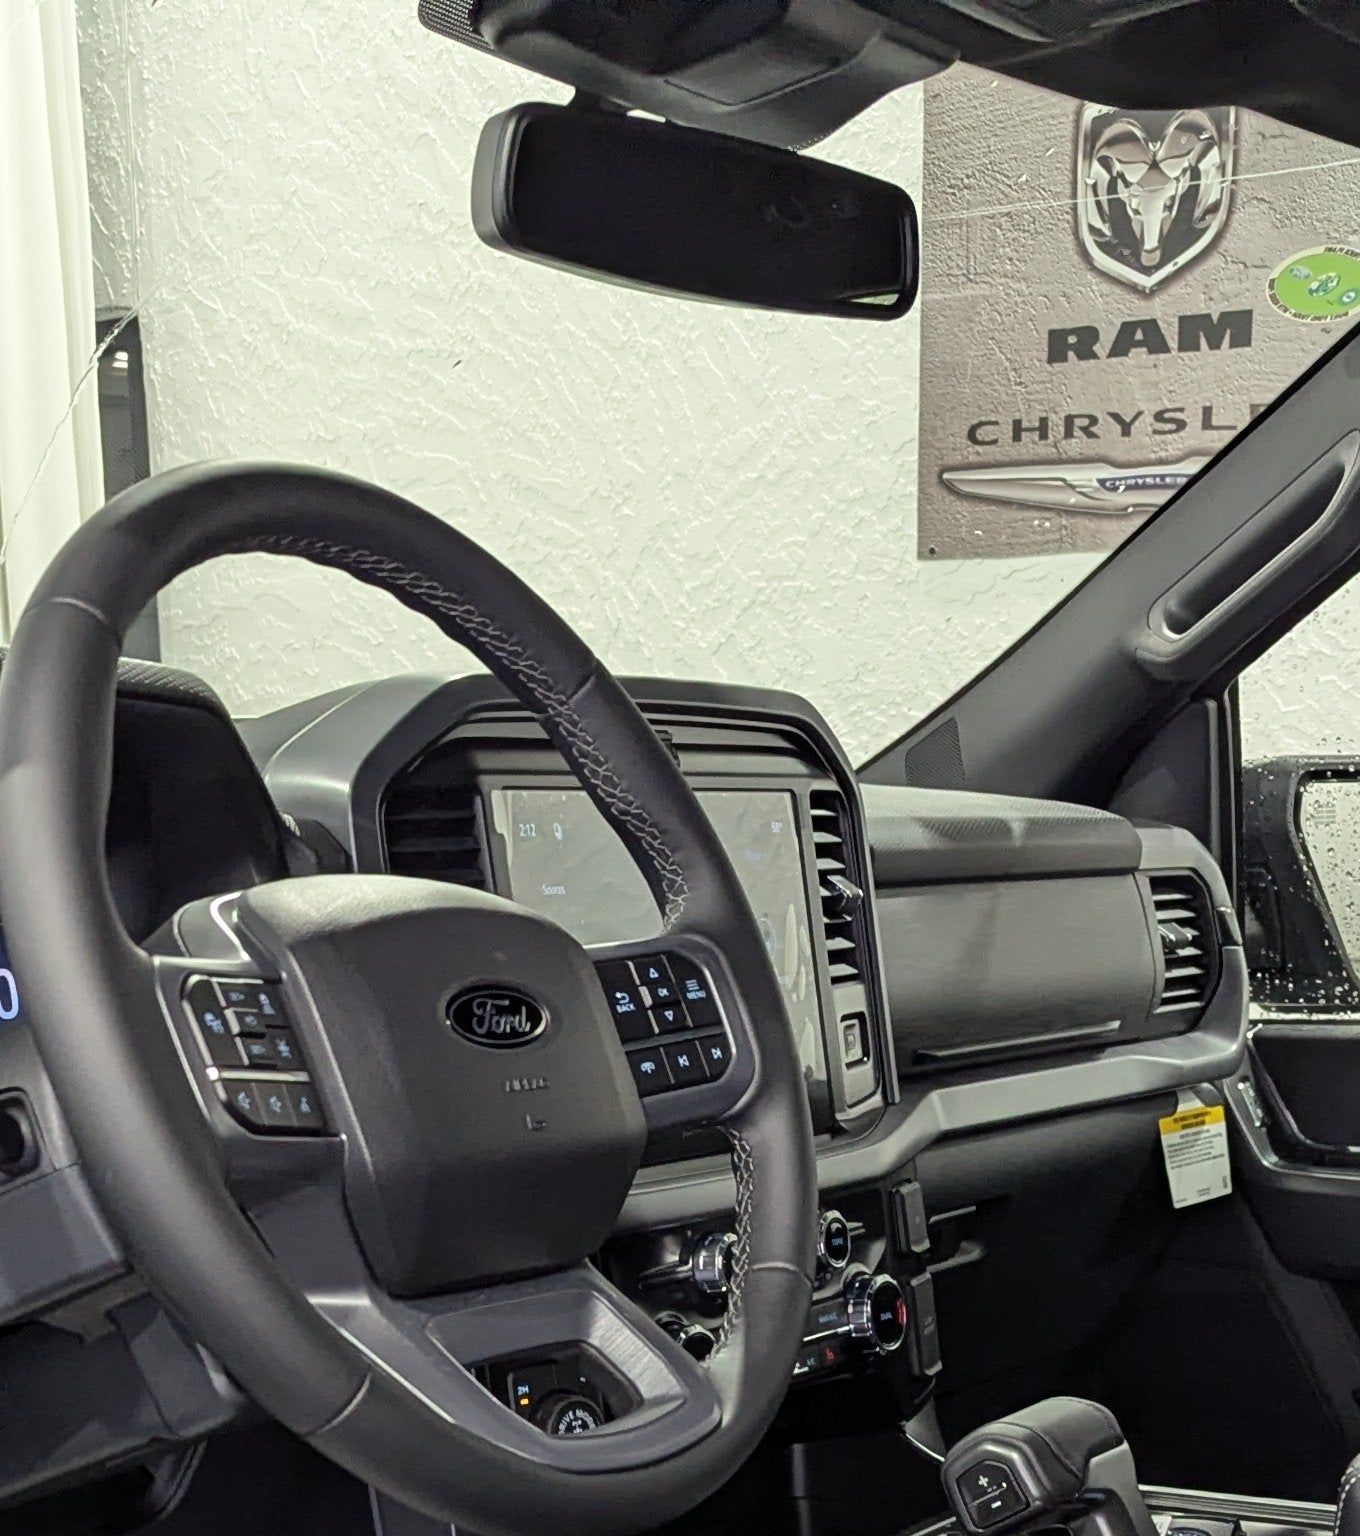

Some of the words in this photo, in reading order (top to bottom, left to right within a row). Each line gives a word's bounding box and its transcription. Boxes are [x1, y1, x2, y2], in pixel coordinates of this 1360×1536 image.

[1047, 309, 1253, 364] RAM
[472, 997, 531, 1034] Ford
[616, 1003, 636, 1013] BACK
